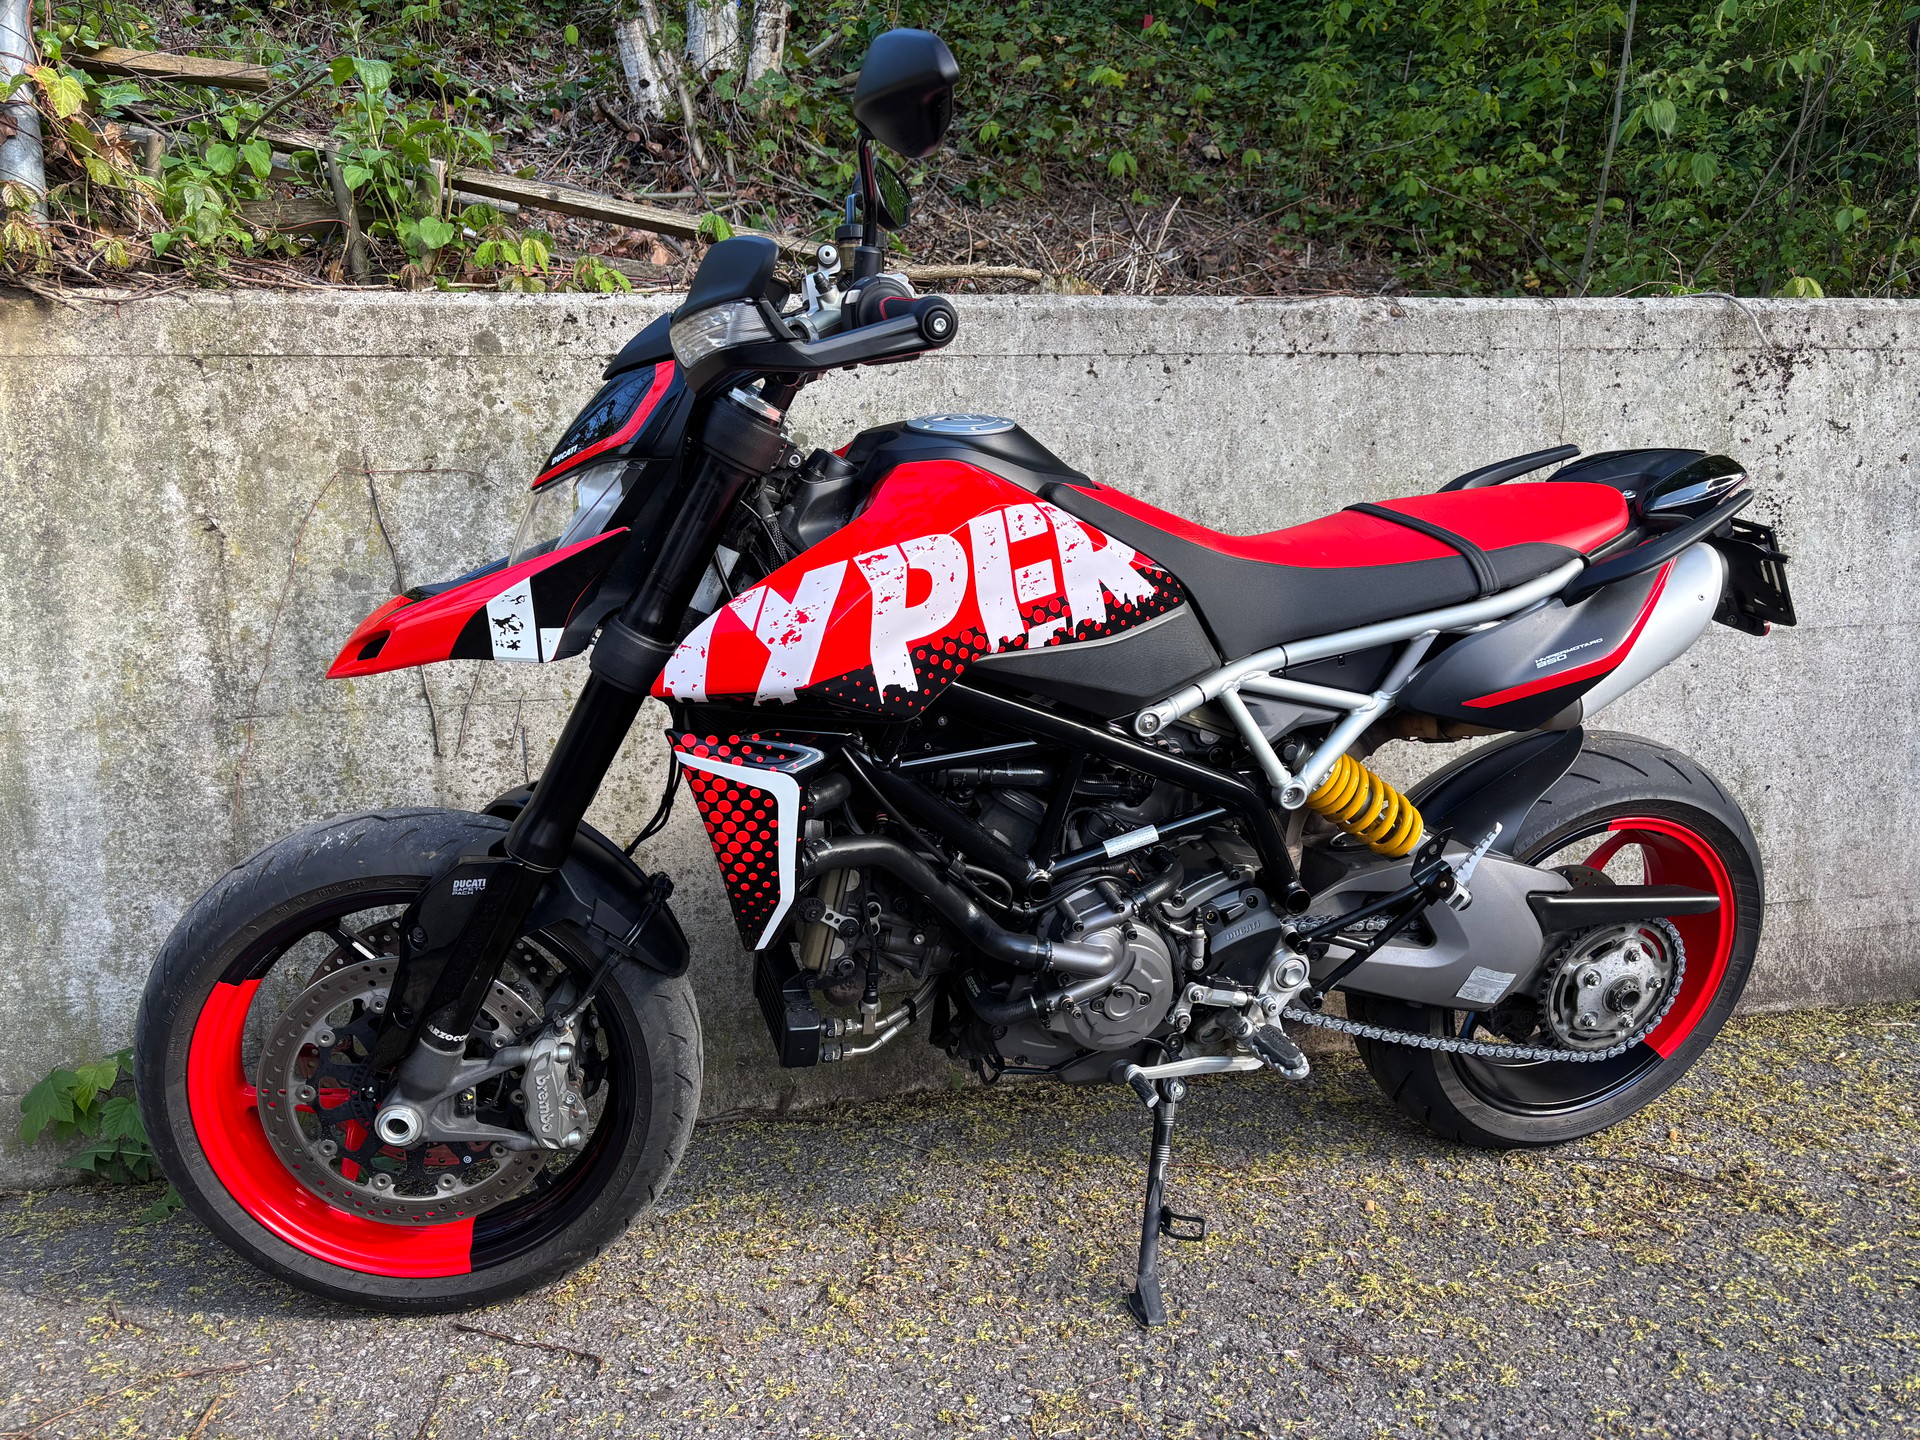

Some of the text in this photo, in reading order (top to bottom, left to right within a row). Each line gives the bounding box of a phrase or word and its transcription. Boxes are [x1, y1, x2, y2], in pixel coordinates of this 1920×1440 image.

[551, 445, 578, 465] DUCATI
[1536, 654, 1567, 669] 950
[453, 879, 486, 888] DUCATI
[1226, 920, 1261, 941] DUCATI
[536, 1074, 554, 1133] brembo
